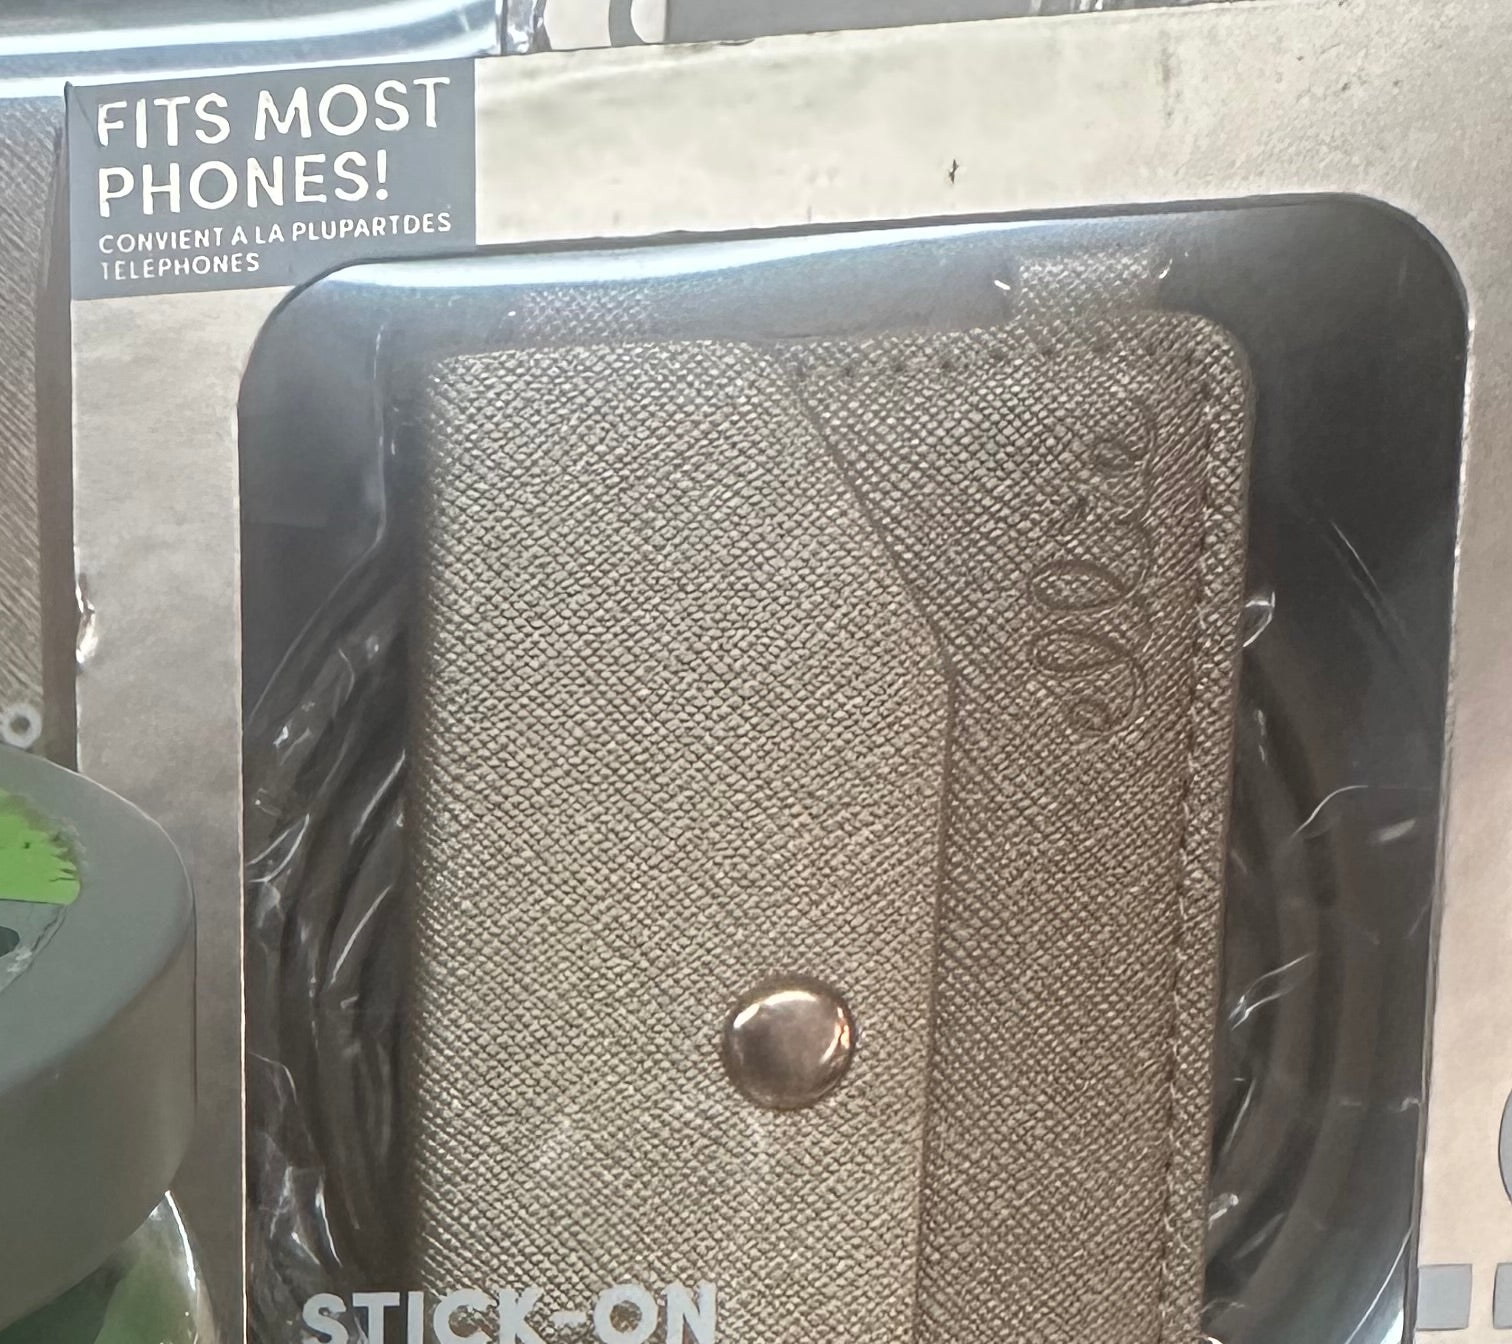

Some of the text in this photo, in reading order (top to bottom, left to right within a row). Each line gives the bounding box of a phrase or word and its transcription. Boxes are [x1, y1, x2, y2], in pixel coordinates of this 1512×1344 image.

[97, 76, 451, 148] FITS MOST
[98, 149, 390, 218] PHONES!
[99, 227, 223, 254] CONVIENT
[255, 223, 285, 245] LA
[101, 253, 260, 280] TELEPHONES
